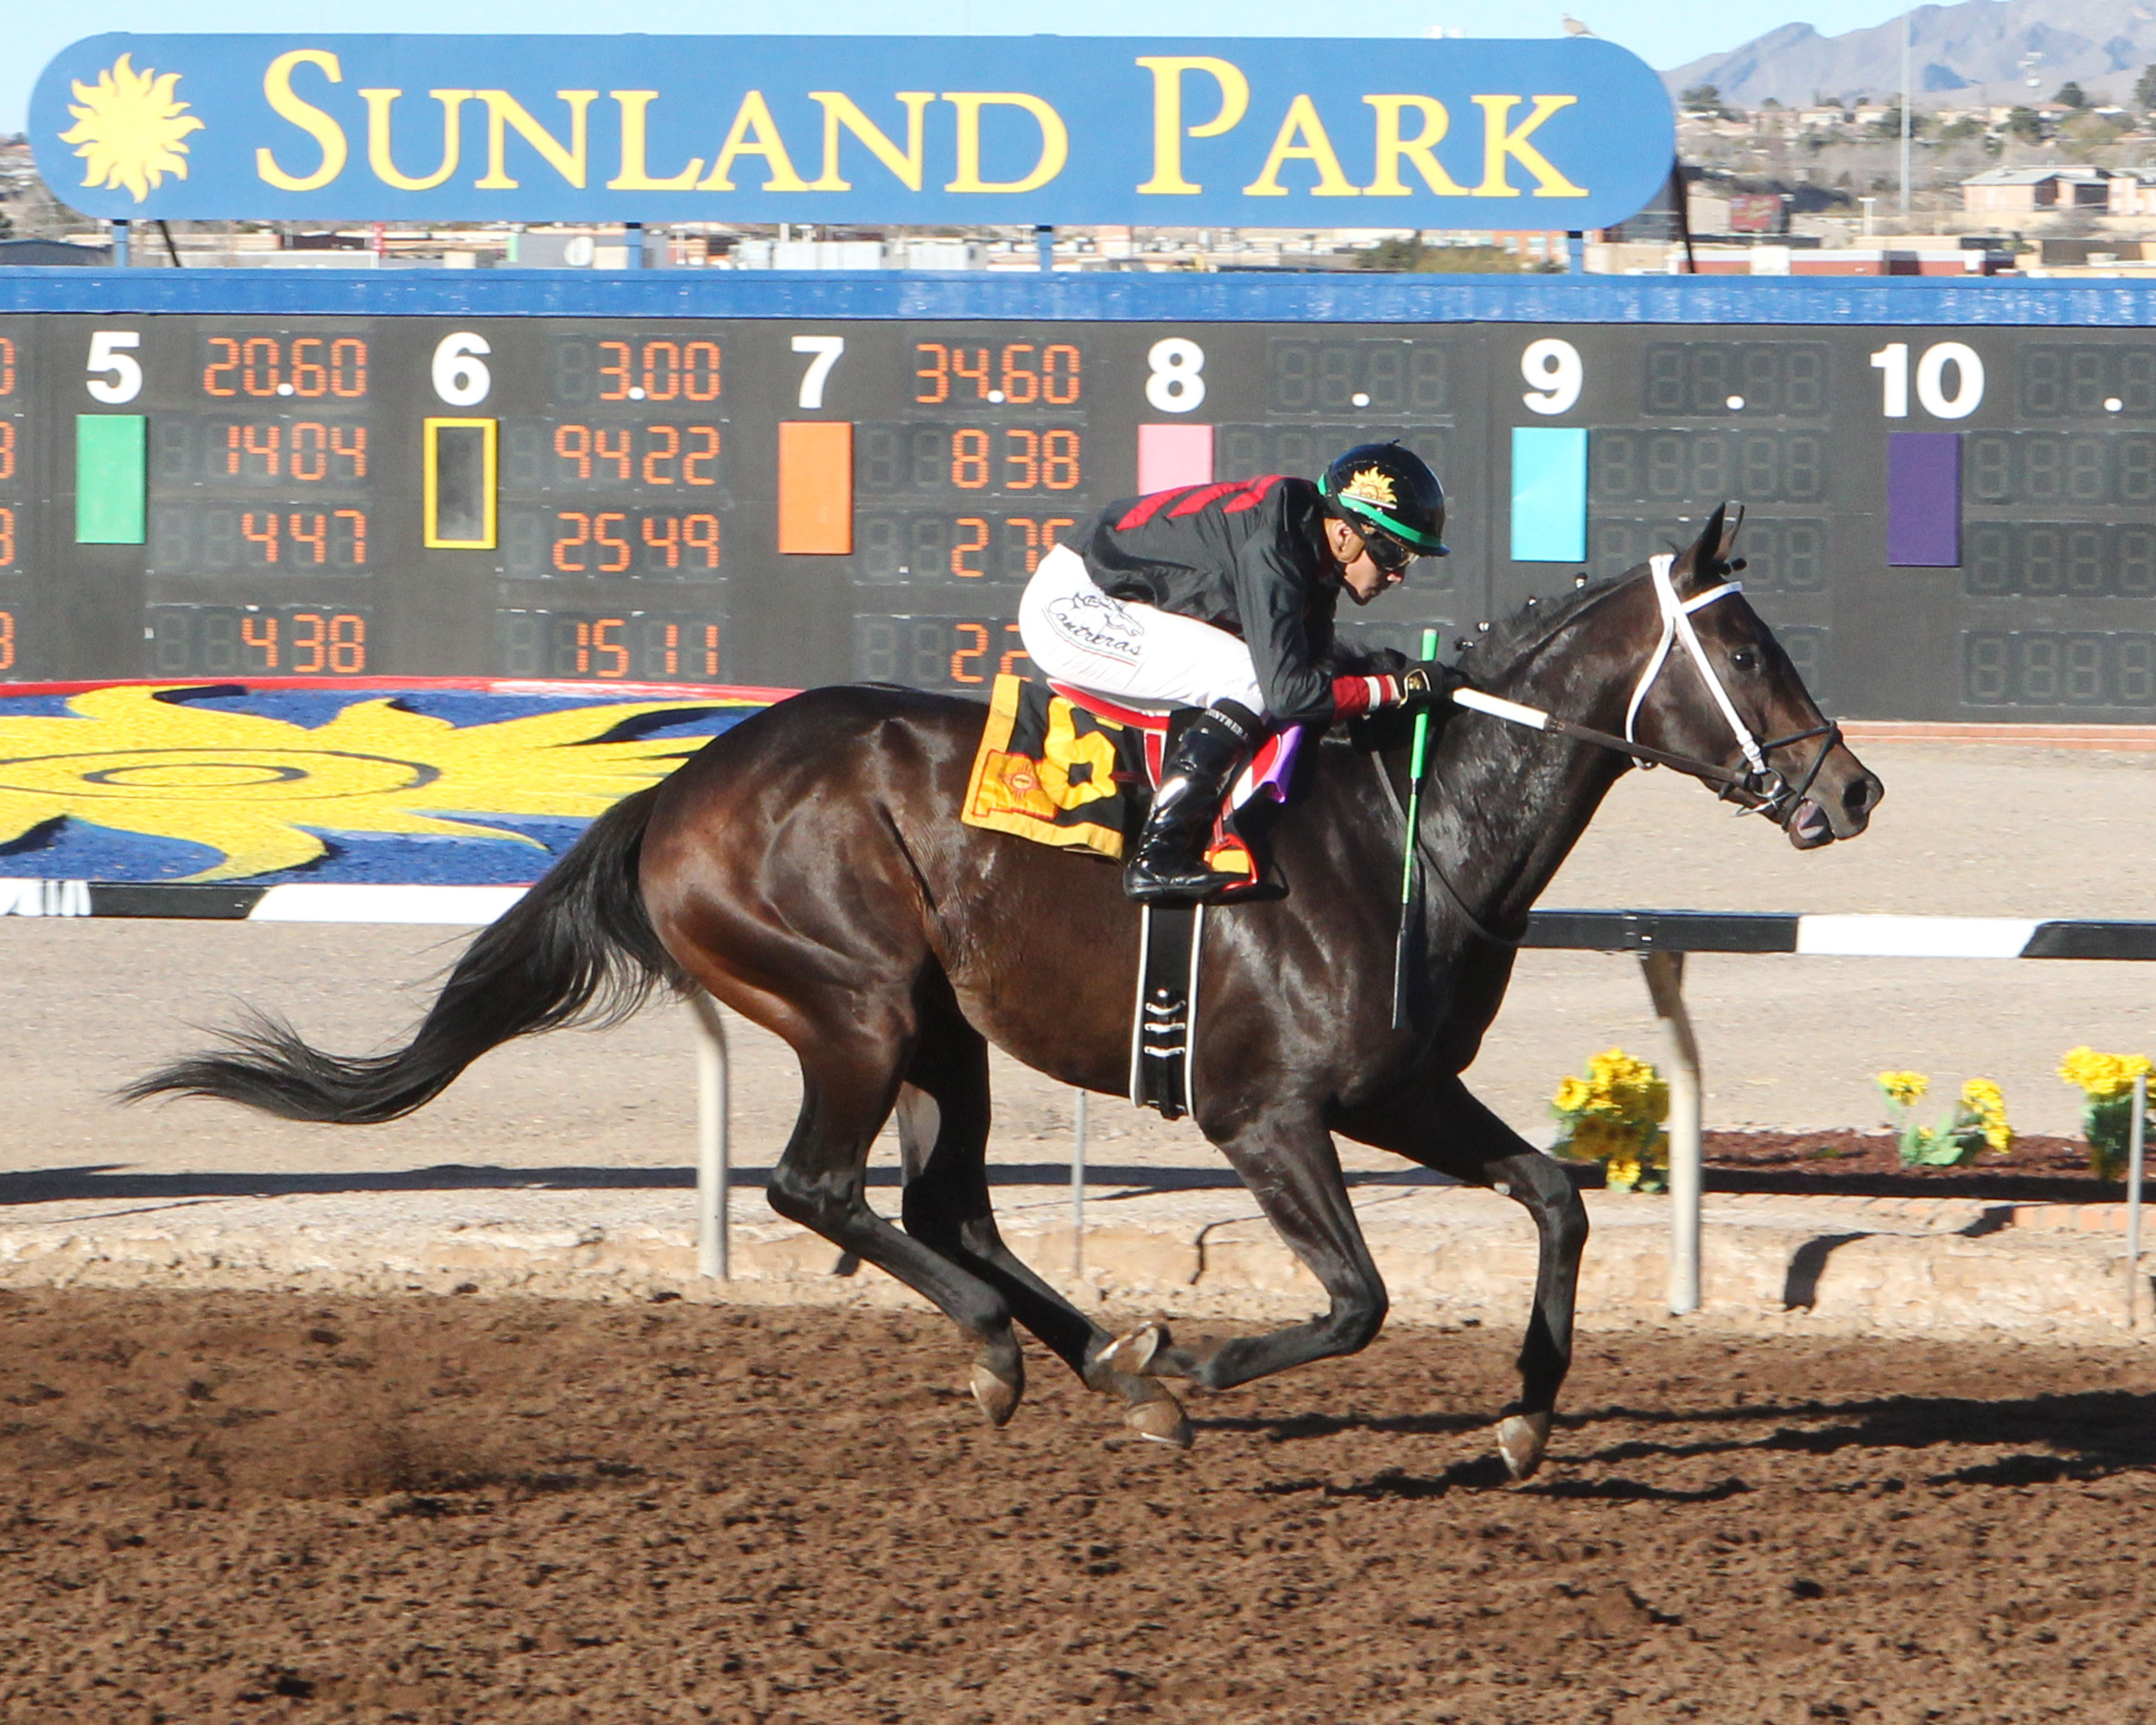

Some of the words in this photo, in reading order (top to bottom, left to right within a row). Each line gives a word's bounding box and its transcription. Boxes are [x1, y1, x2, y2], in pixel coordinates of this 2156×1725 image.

[258, 49, 1067, 192] SUNLAND
[1138, 57, 1588, 197] PARK
[87, 331, 142, 404] 5
[204, 337, 367, 398] 20.60
[432, 332, 490, 406] 6
[599, 341, 721, 401] 3.00
[792, 336, 844, 408] 7
[916, 343, 1080, 404] 34.60
[1146, 338, 1205, 413] 8
[1522, 339, 1582, 414] 9
[1871, 342, 1984, 419] 10
[228, 421, 367, 481] 1404
[555, 424, 720, 486] 9422
[951, 428, 1080, 490] 838
[242, 509, 367, 564] 447
[553, 512, 719, 572] 2549
[241, 613, 366, 674] 438
[572, 619, 719, 678] 1511
